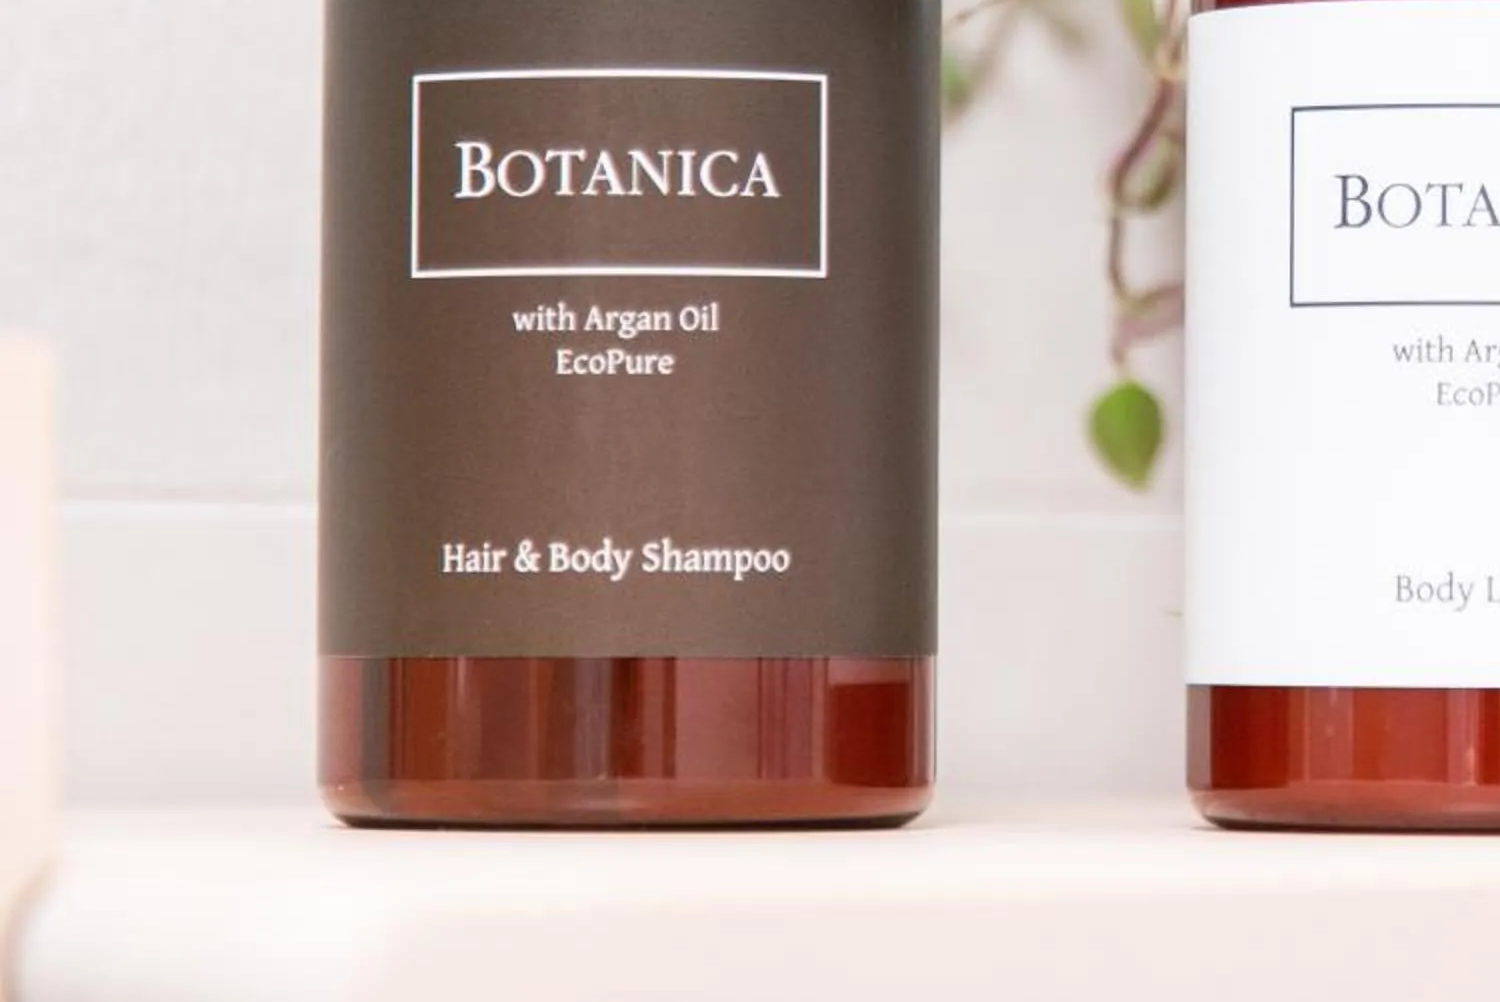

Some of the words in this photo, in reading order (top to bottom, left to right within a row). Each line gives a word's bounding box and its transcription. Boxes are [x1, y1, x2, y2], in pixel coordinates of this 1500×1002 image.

[454, 141, 781, 199] BOTANICA
[512, 300, 577, 332] with
[583, 304, 673, 340] Argan
[678, 301, 720, 332] Oil
[556, 347, 676, 375] EcoPure
[1392, 333, 1454, 364] with
[442, 541, 509, 573] Hair
[513, 538, 542, 573] &
[548, 536, 634, 582] Body
[641, 536, 791, 582] Shampoo
[1395, 570, 1474, 613] Body
